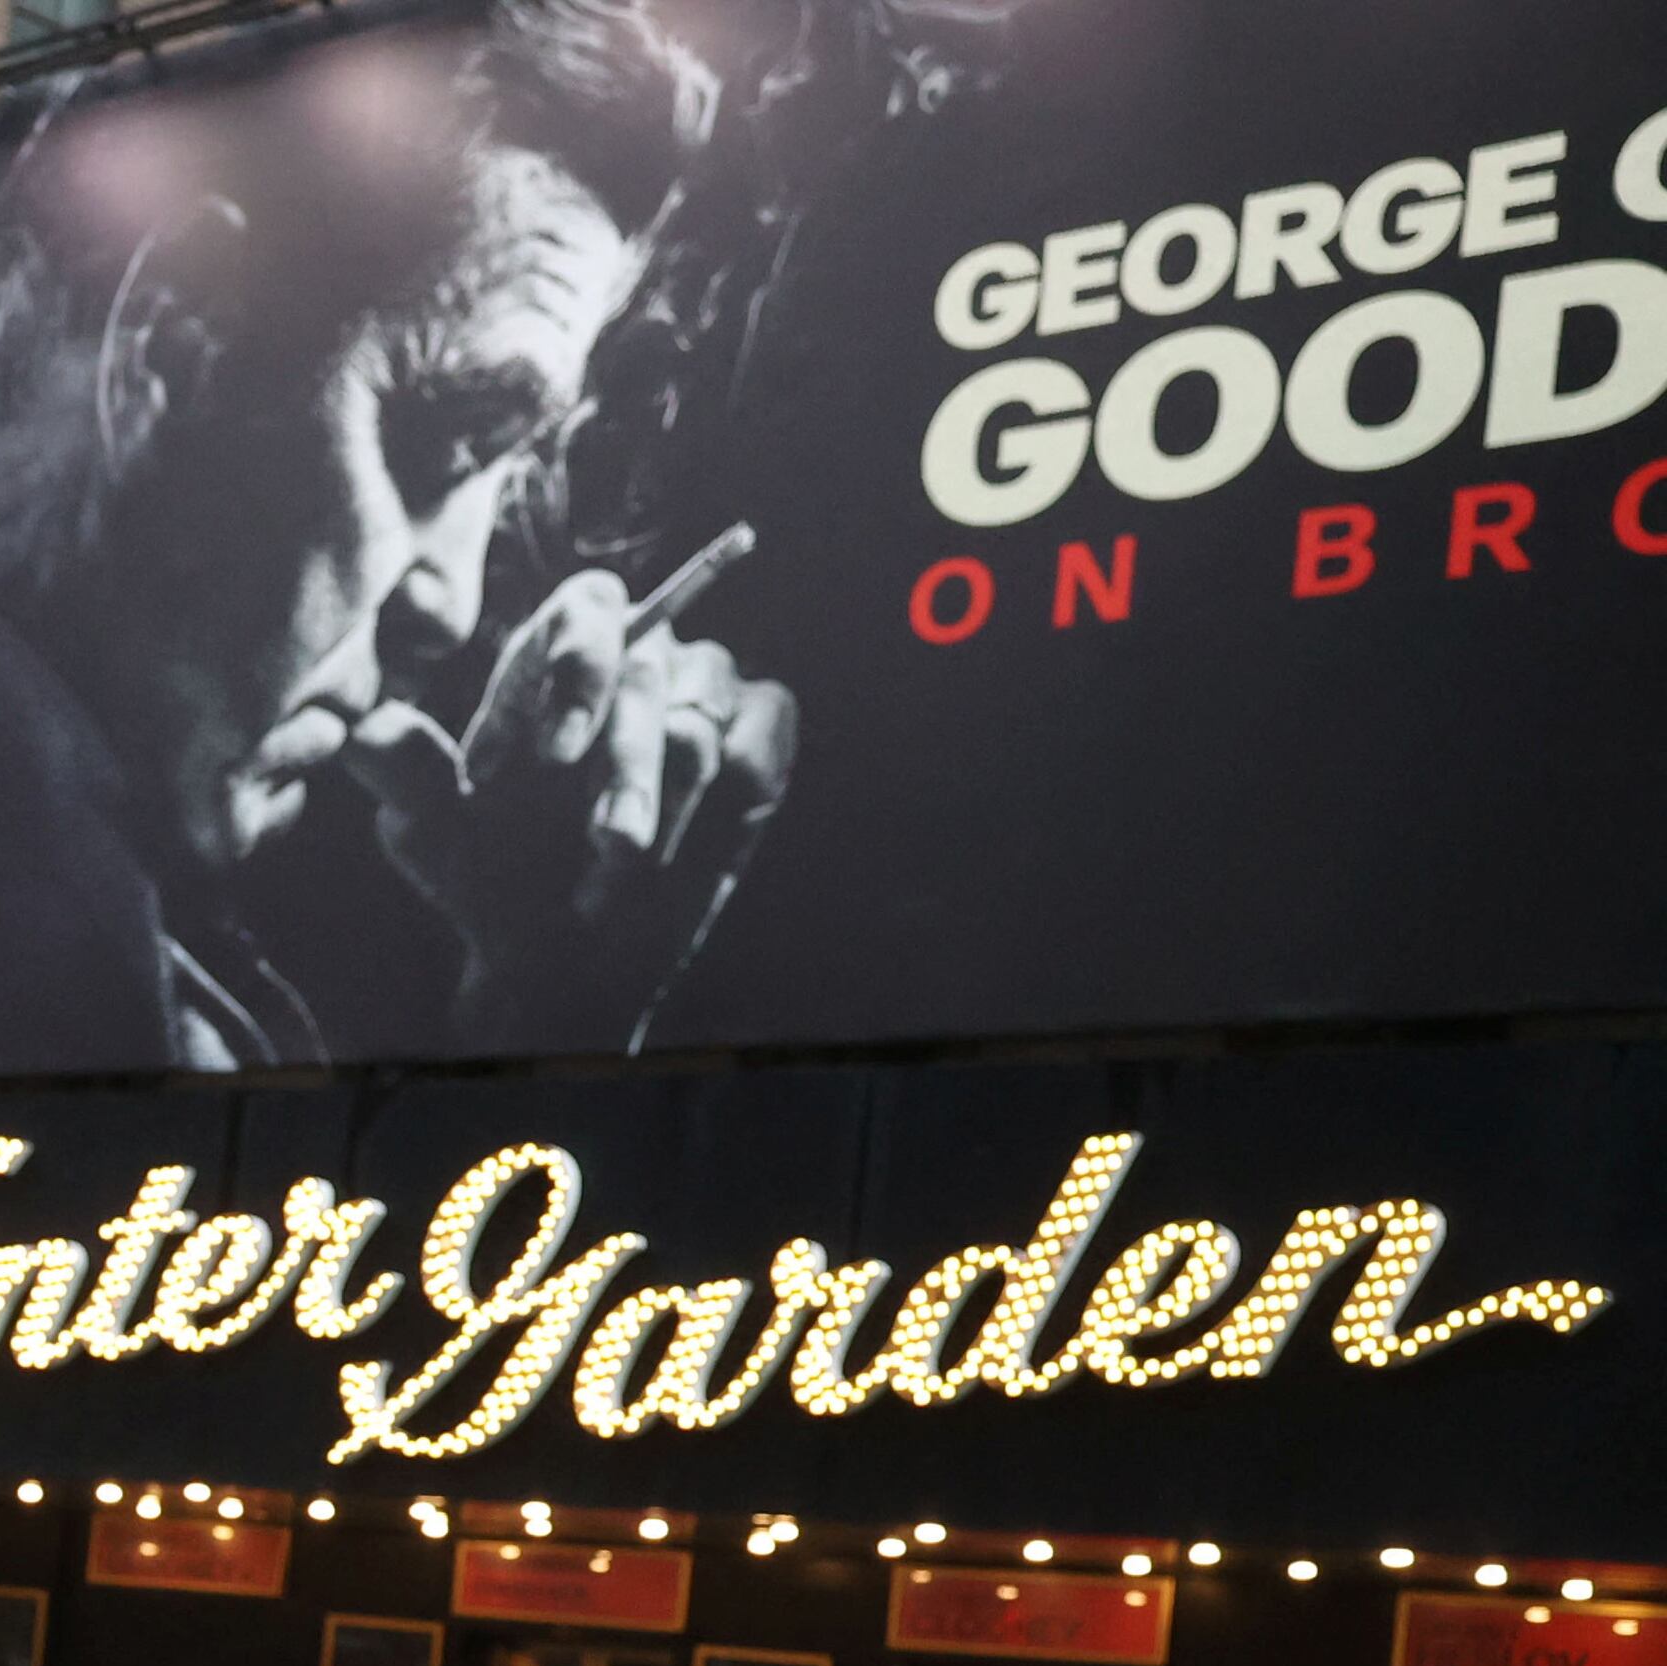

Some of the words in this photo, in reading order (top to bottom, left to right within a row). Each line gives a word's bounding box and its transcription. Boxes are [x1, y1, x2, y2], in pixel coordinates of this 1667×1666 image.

[933, 130, 1568, 350] GEORGE
[920, 259, 1667, 527] GOOD
[909, 536, 1137, 645] ON
[329, 1131, 1615, 1465] Garden
